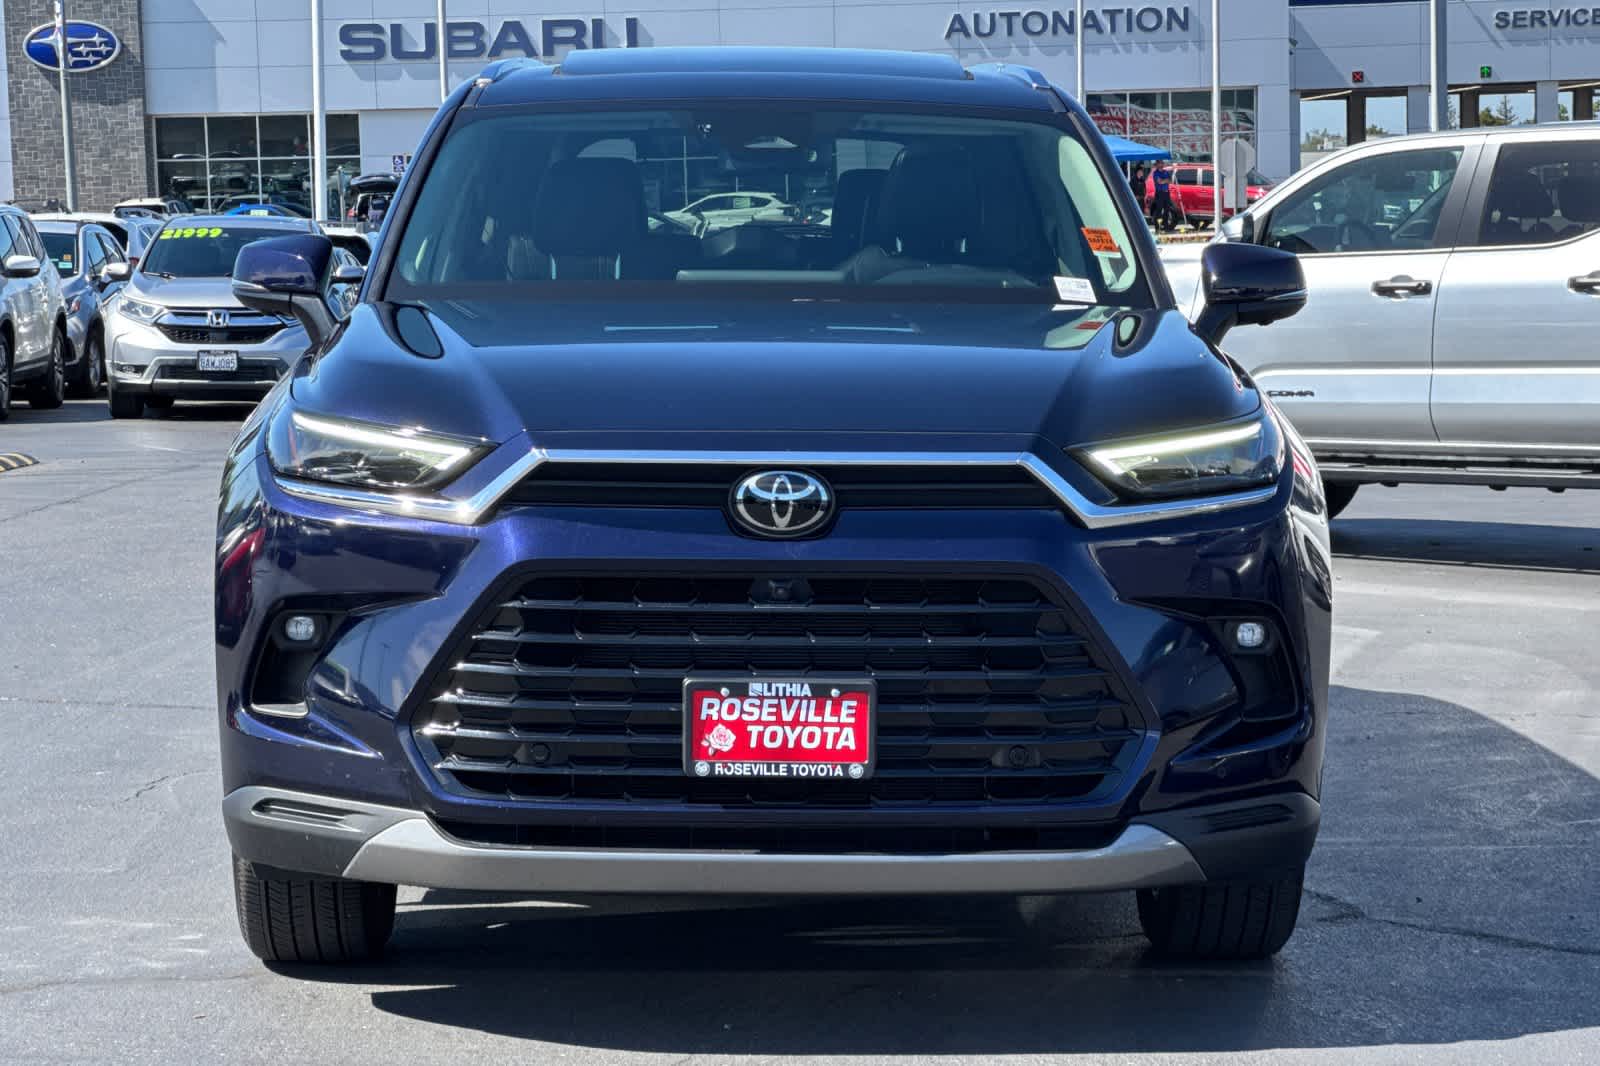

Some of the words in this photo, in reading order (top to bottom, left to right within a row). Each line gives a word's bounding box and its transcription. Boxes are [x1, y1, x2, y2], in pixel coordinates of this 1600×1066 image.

[944, 6, 1190, 40] AUTONATION
[338, 17, 638, 61] SUBARU
[159, 227, 223, 240] 21999
[762, 683, 812, 697] LITHIA
[700, 697, 858, 723] ROSEVILLE
[746, 725, 857, 750] TOYOTA
[714, 763, 788, 776] ROSEVILLE
[791, 764, 844, 777] TOYOTA
